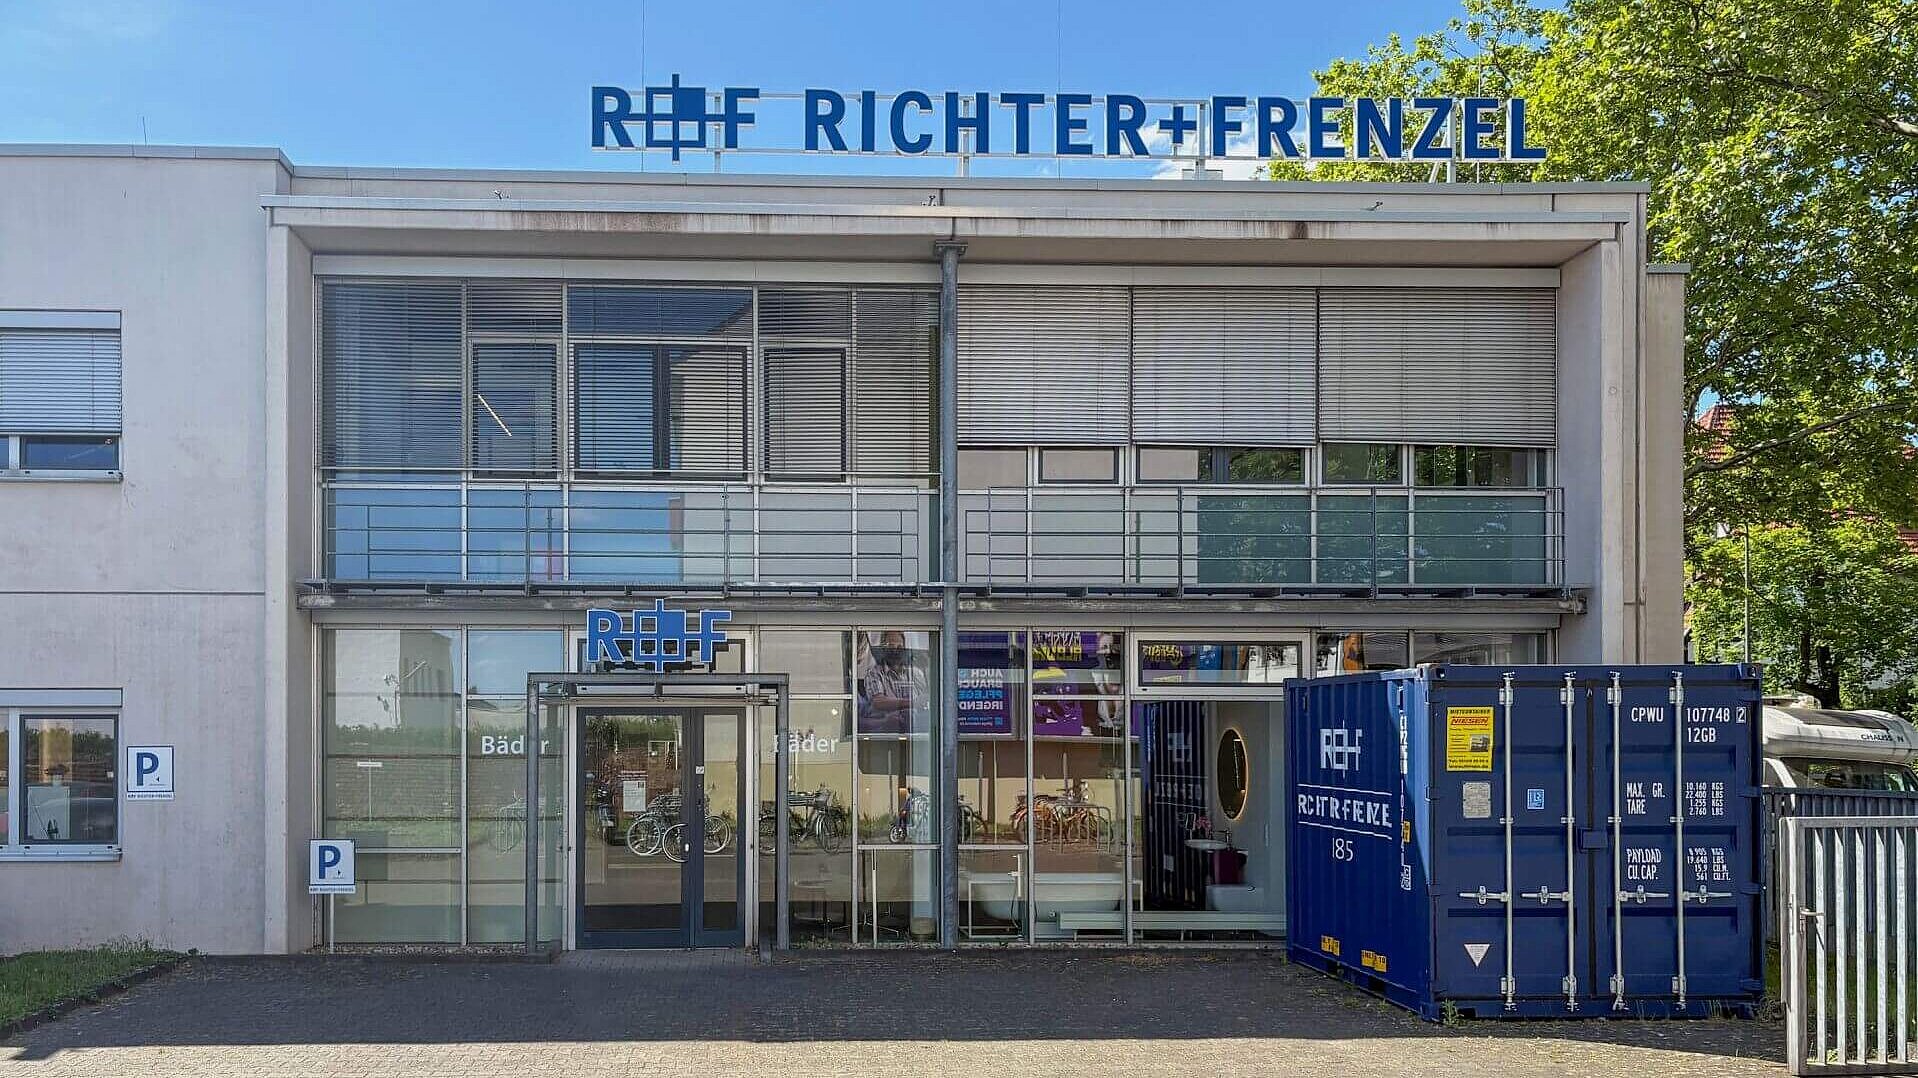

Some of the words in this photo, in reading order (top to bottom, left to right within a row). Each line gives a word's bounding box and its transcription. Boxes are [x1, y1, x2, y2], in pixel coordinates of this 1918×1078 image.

[804, 88, 1547, 160] RICHTER+FRENZEL
[1631, 707, 1664, 722] CPWU
[1687, 707, 1730, 722] 107748
[1687, 727, 1716, 743] 12GB
[481, 734, 550, 755] Bädr
[773, 734, 839, 753] äder
[136, 752, 159, 786] P
[1626, 782, 1646, 798] MAX.
[1652, 782, 1666, 798] GR.
[1686, 782, 1707, 791] 10.160
[1711, 782, 1724, 791] KGS
[1685, 791, 1707, 799] 22.400
[1711, 791, 1724, 799] LBS
[1627, 798, 1647, 815] TARE
[1711, 799, 1724, 807] KGS
[1711, 807, 1724, 816] LBS
[1332, 836, 1354, 862] 185
[1626, 848, 1662, 863] PAYLOAD
[318, 845, 341, 879] P
[1712, 855, 1725, 864] LBS
[1696, 872, 1708, 881] 561
